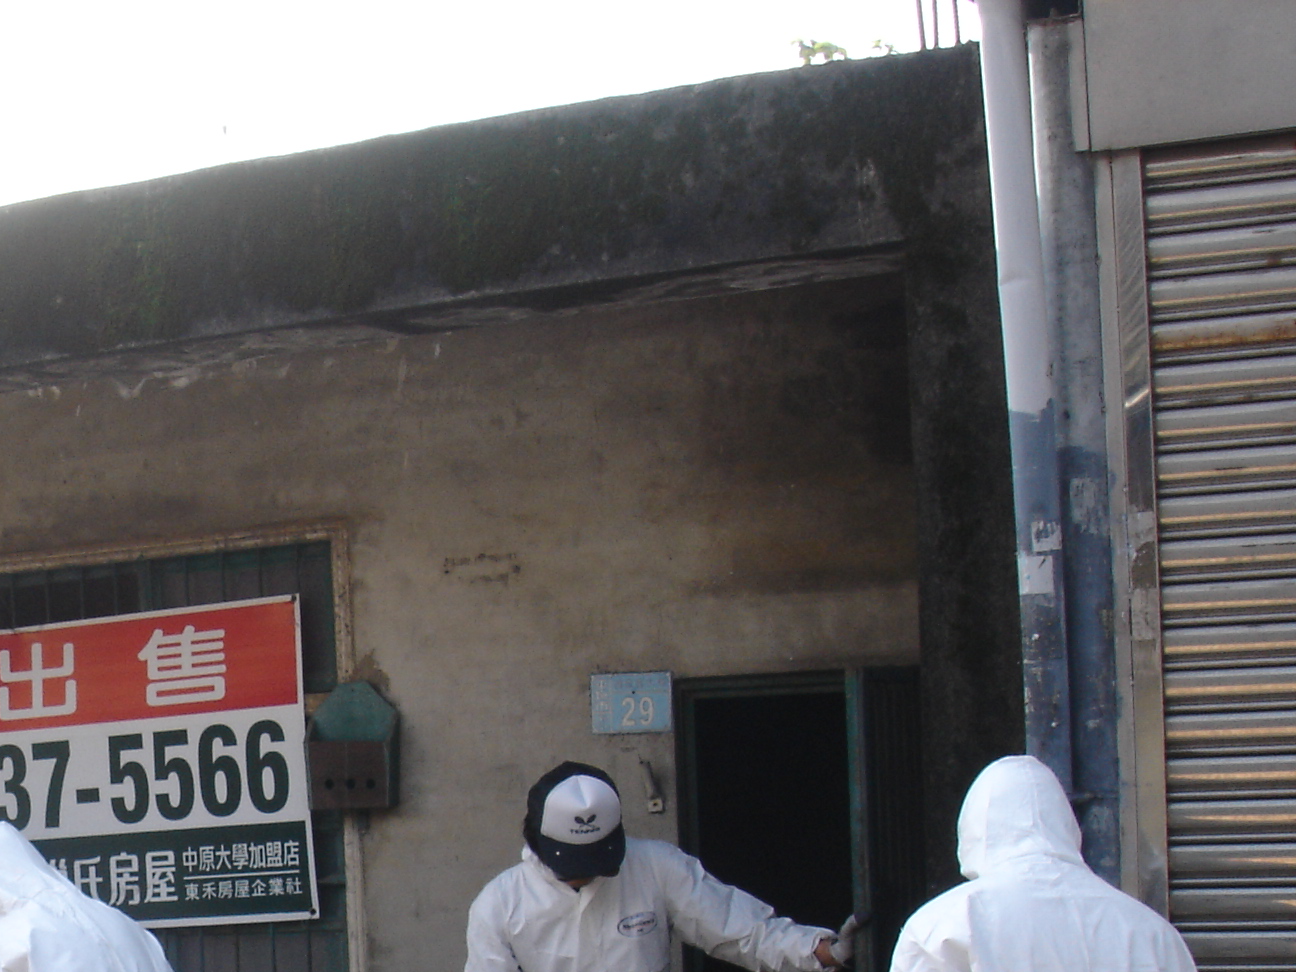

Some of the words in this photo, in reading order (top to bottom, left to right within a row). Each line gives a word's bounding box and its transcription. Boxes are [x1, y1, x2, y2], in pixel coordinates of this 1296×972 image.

[621, 696, 654, 727] 29
[182, 839, 300, 873] 中原大學加盟店
[49, 850, 180, 908] 氏房屋
[184, 876, 303, 902] 東禾房屋企業社
